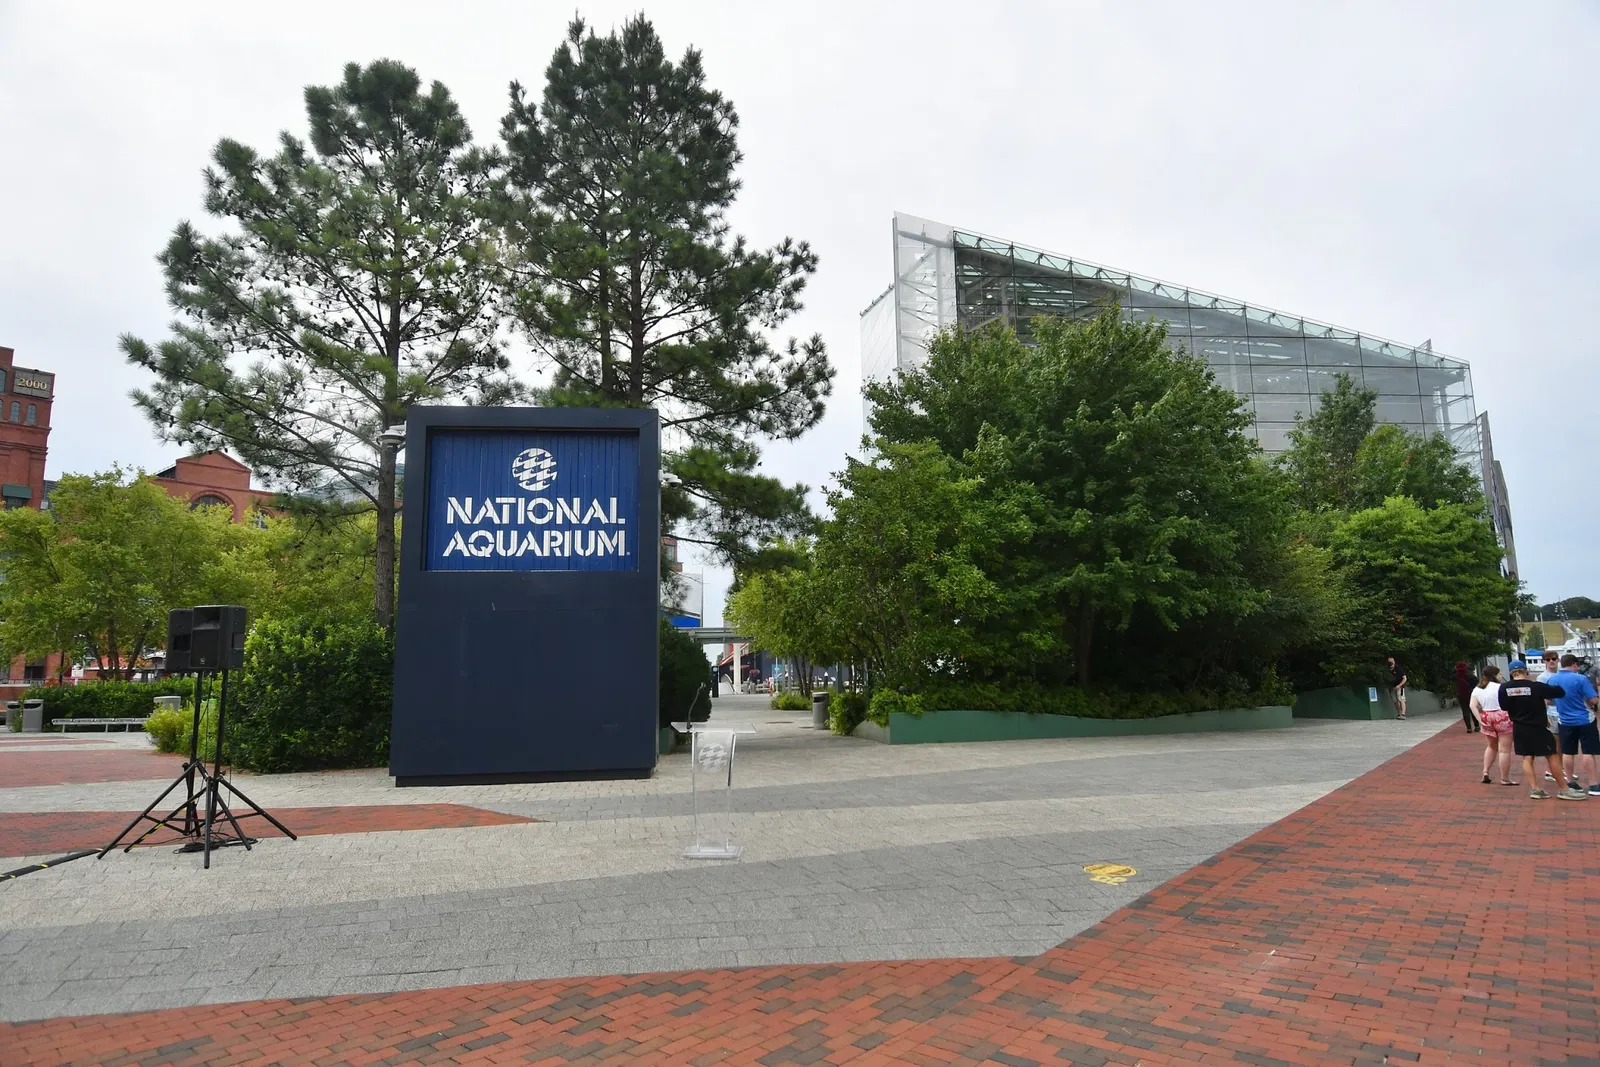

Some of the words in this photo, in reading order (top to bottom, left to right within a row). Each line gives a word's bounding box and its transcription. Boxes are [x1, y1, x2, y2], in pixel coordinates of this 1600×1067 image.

[18, 378, 47, 390] 2000
[446, 497, 626, 525] NATIONAL
[442, 529, 627, 558] AQUARIUM
